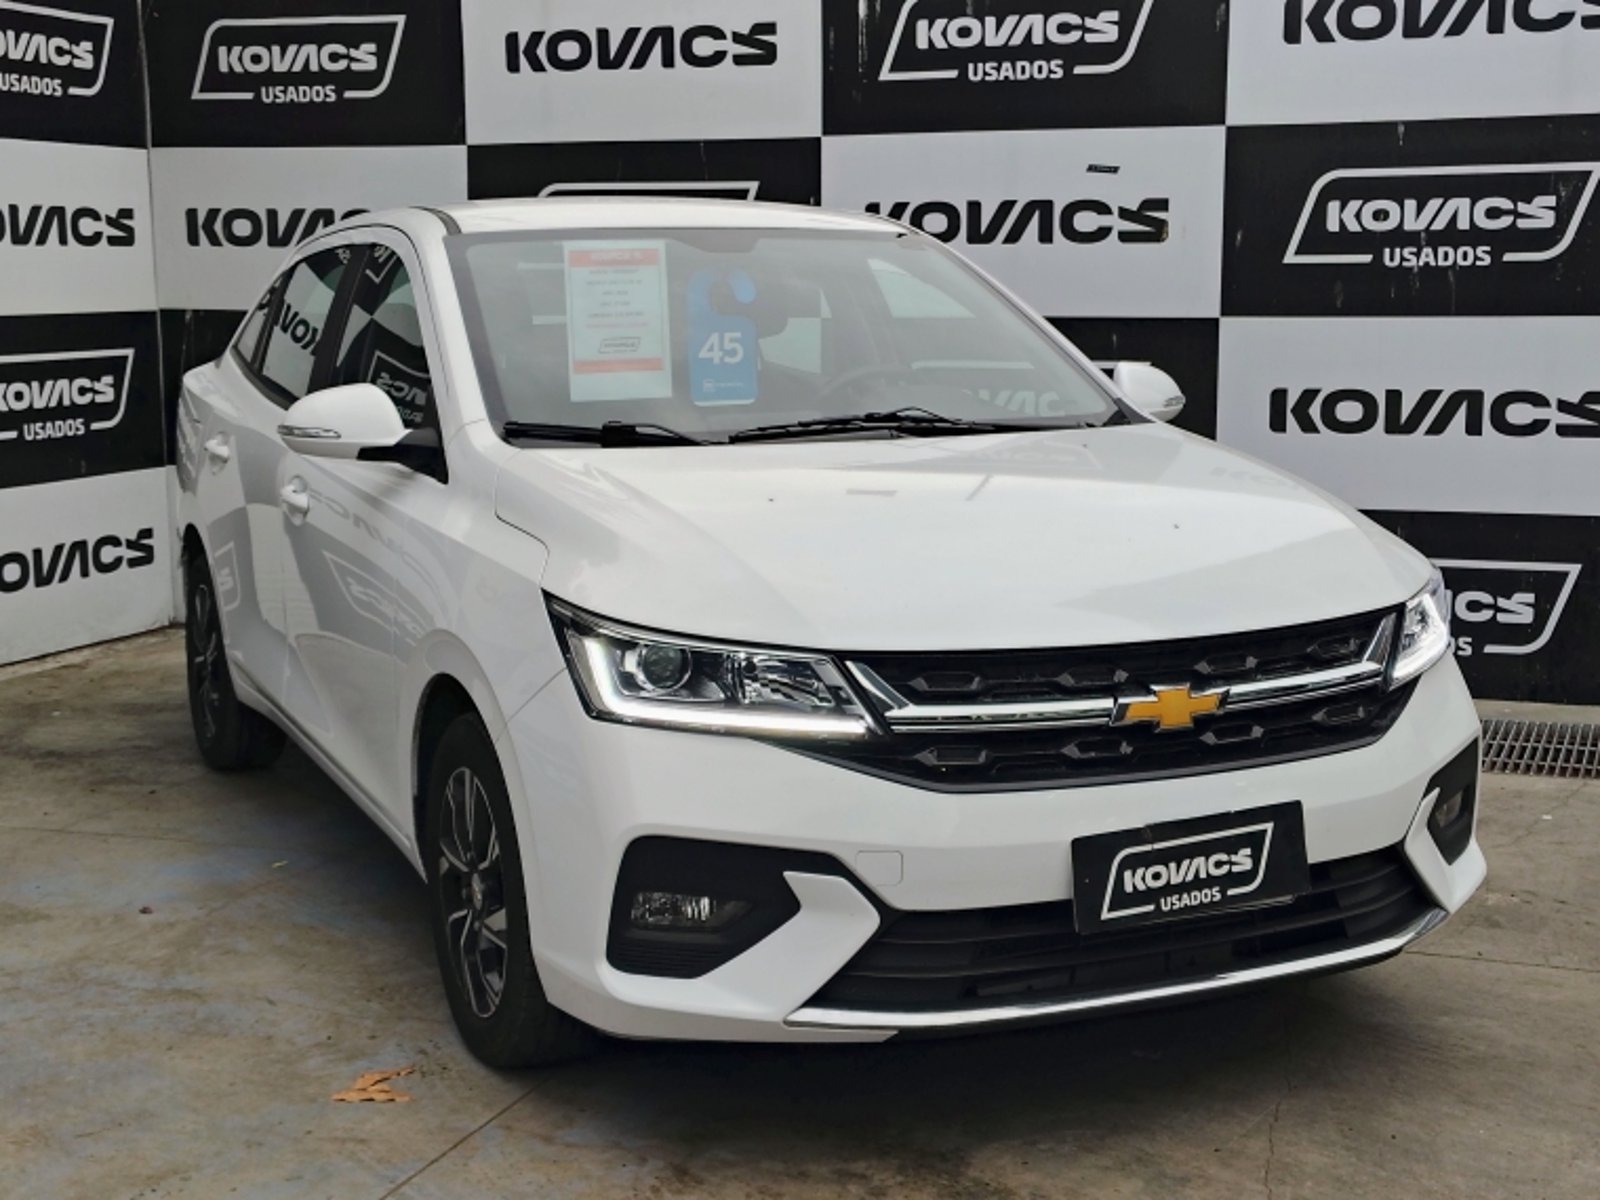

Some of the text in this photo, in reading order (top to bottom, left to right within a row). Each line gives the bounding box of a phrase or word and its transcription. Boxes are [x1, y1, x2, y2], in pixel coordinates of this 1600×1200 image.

[915, 10, 1120, 49] KOVACS
[1283, 0, 1600, 44] KOVAC
[217, 43, 378, 73] KOVACS
[504, 21, 777, 74] KOVACS
[0, 72, 63, 97] USADOS
[967, 60, 1064, 81] USADOS
[260, 85, 336, 103] USADOS
[0, 204, 135, 247] VACS
[185, 208, 371, 247] KOVA
[1326, 195, 1556, 232] KOVACS
[1383, 246, 1491, 267] USADOS
[698, 332, 744, 365] 45
[23, 418, 85, 440] USADOS
[1123, 847, 1253, 893] KOVACS
[1160, 886, 1221, 912] USADOS
